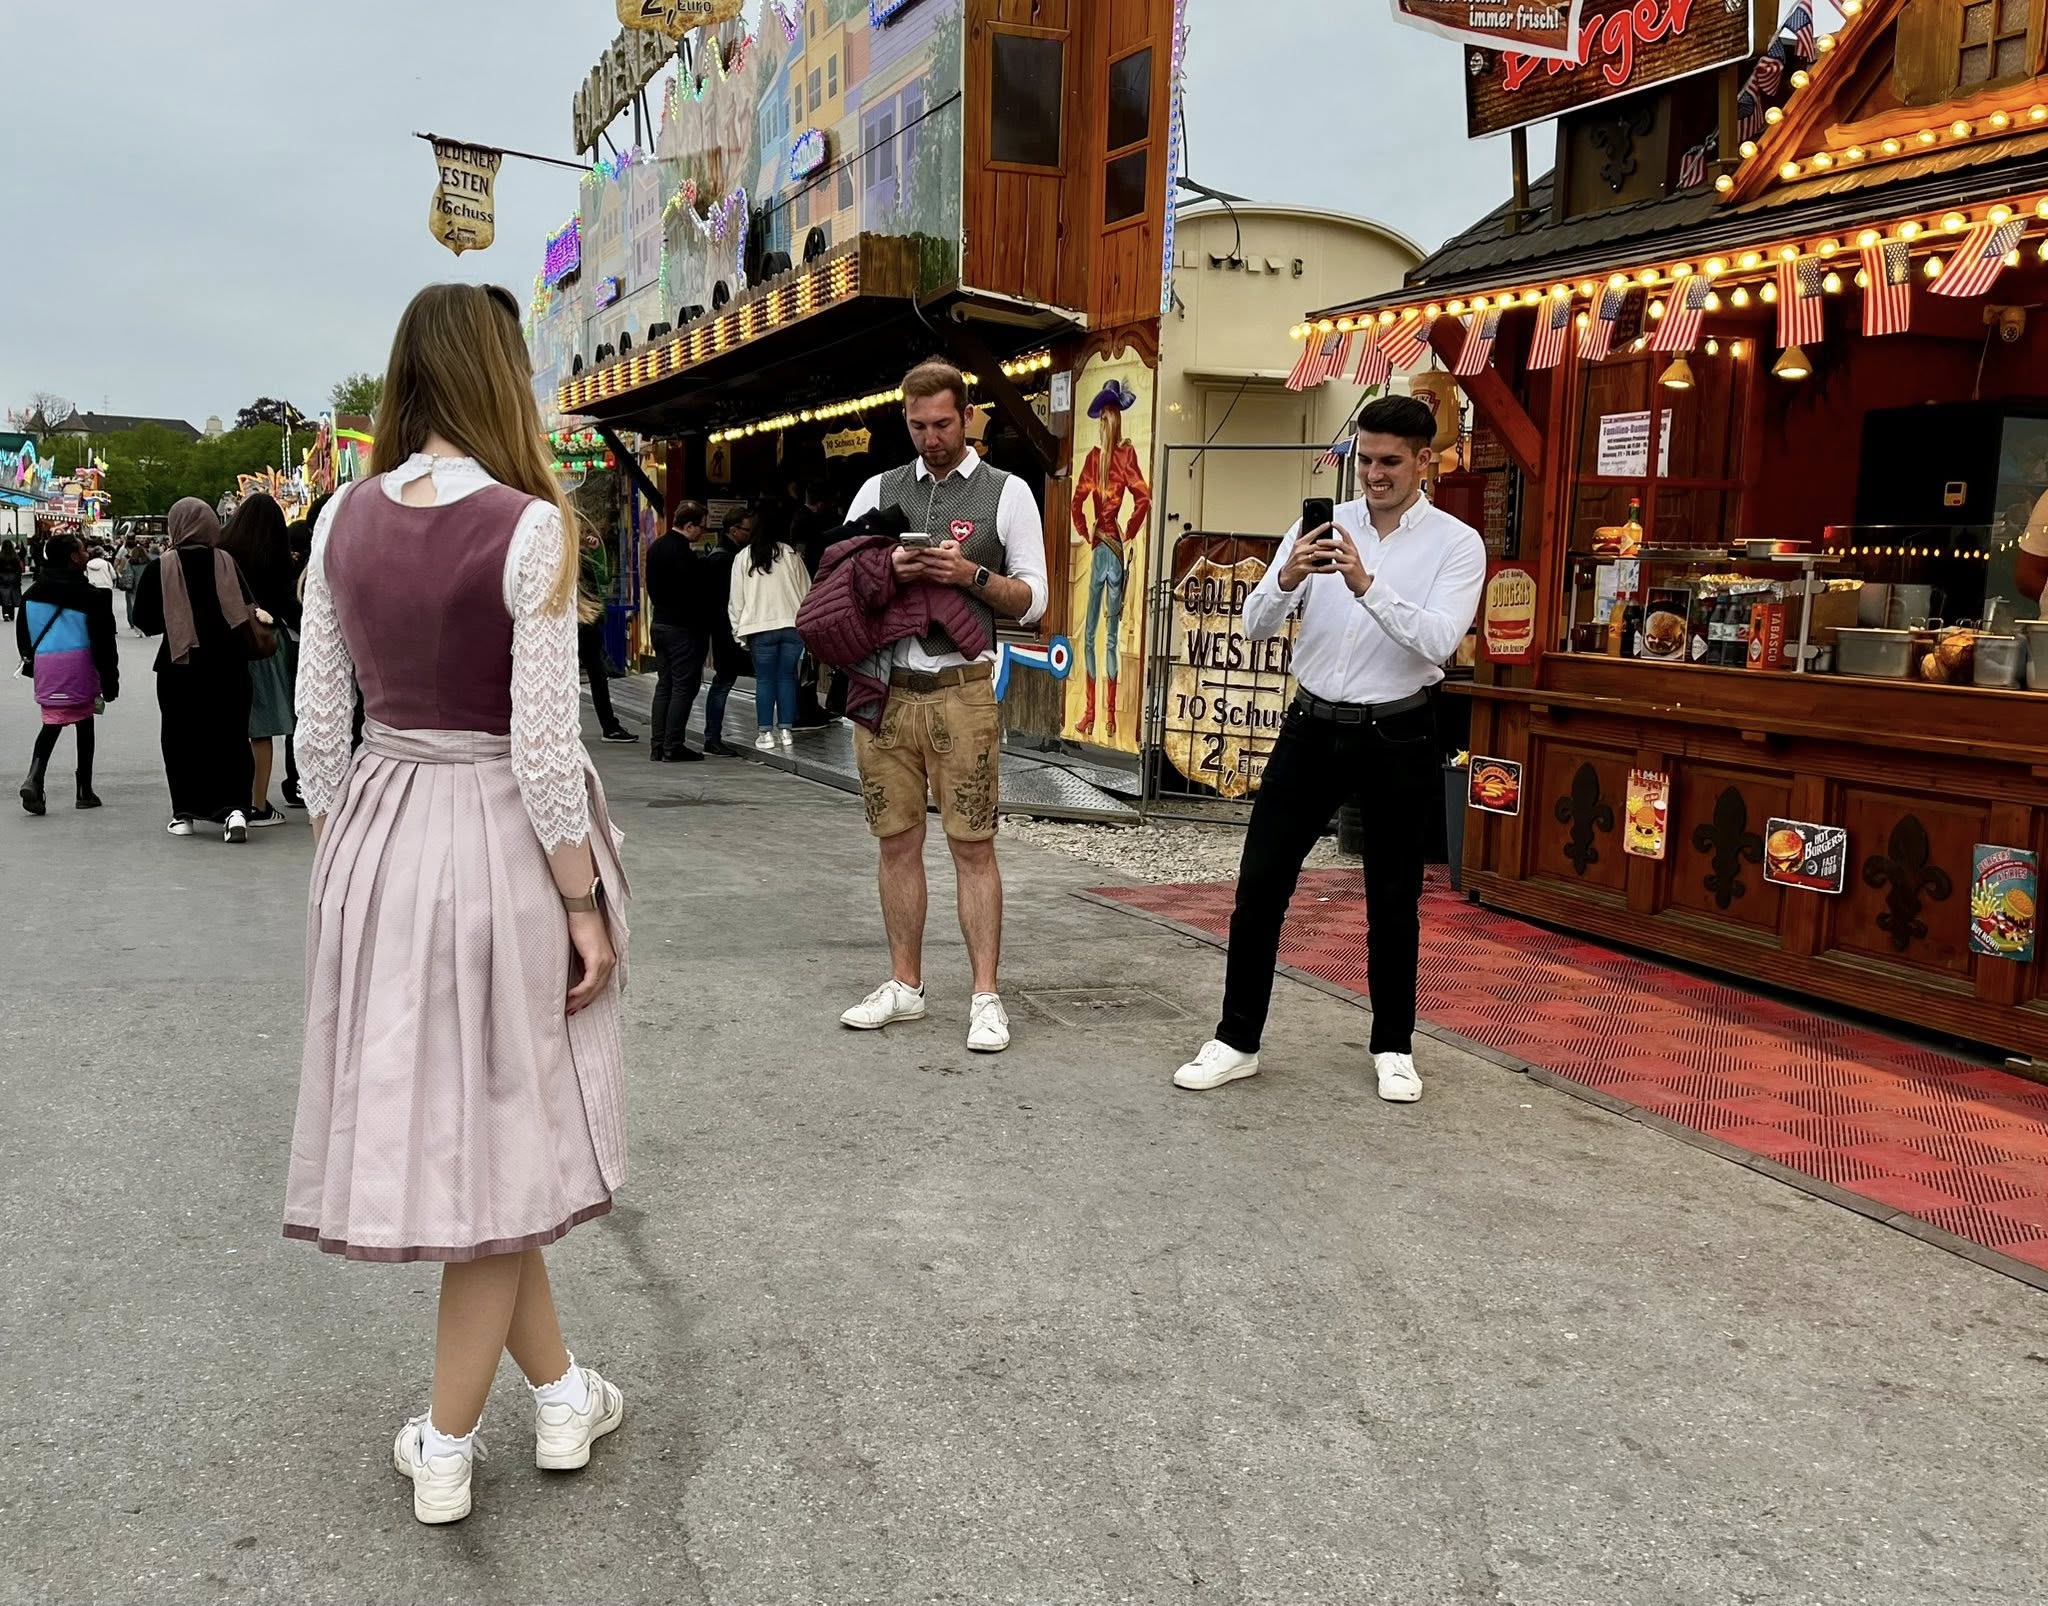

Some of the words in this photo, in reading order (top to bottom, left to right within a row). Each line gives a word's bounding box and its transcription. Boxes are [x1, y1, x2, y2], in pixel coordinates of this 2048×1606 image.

[1469, 5, 1513, 28] immer
[1516, 5, 1559, 31] frisch!
[435, 143, 496, 174] OLDENER
[441, 167, 489, 197] ESTEN
[1036, 403, 1047, 416] 10
[1492, 582, 1531, 607] BURGERS
[1767, 612, 1782, 662] TABASCO
[1176, 693, 1207, 721] 10
[1814, 829, 1829, 845] HOT
[1820, 864, 1837, 877] FOOD
[1822, 855, 1837, 867] FAST
[1971, 922, 1983, 935] BUY
